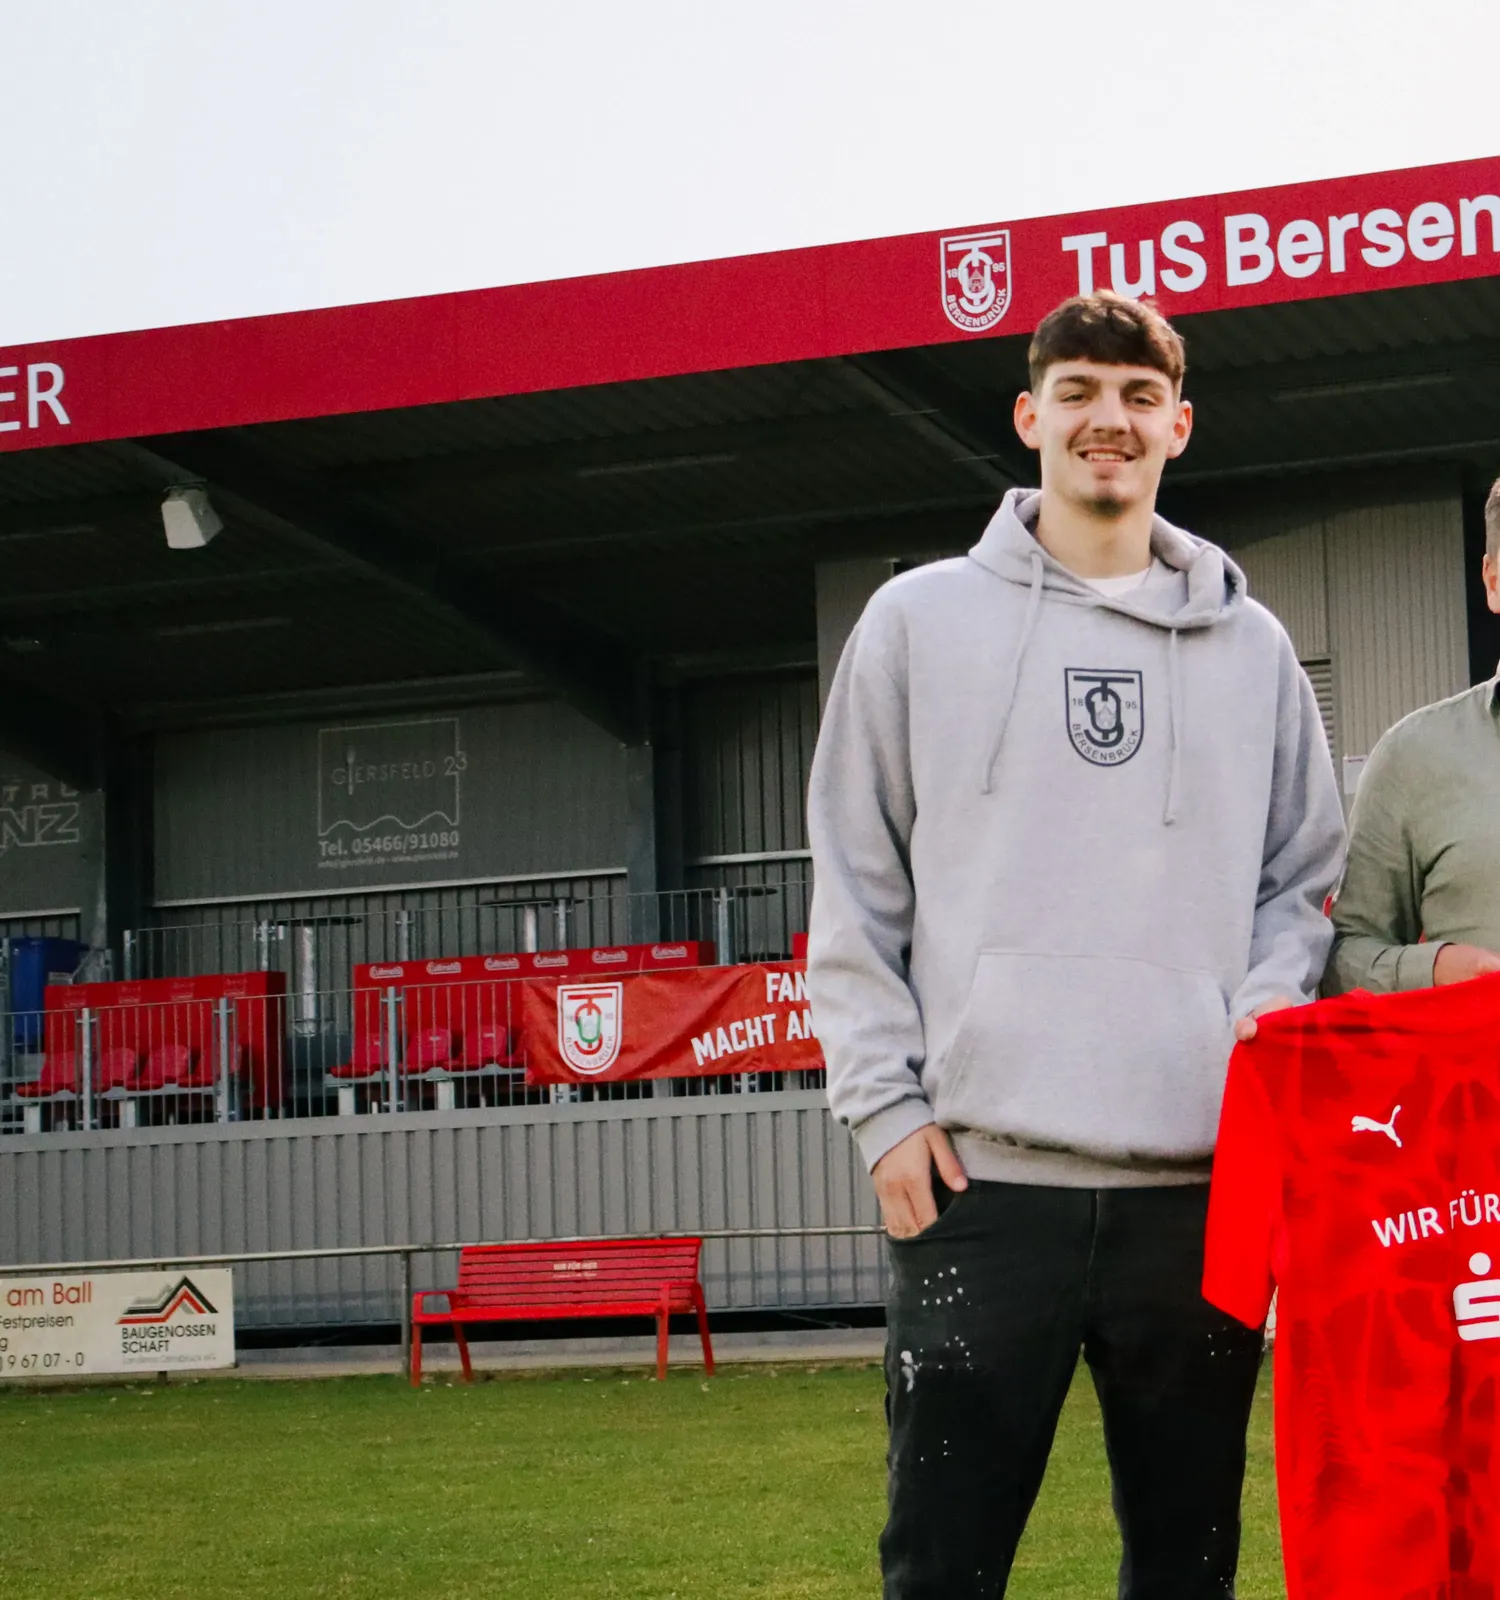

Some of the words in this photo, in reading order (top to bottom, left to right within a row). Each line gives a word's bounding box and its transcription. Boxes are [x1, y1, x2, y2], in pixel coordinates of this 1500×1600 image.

[1061, 220, 1208, 303] TuS
[0, 362, 71, 432] ER
[1072, 723, 1138, 761] BERSENBRÜCK
[444, 750, 468, 776] 23
[318, 838, 349, 857] Tel.
[351, 831, 460, 854] 05466/91080
[690, 1013, 777, 1067] MACHT
[1371, 1207, 1444, 1248] WIR
[7, 1287, 44, 1307] am
[53, 1281, 92, 1305] Ball
[121, 1324, 216, 1339] BAUGENOSSEN
[7, 1354, 16, 1369] 9
[21, 1353, 38, 1369] 67
[43, 1352, 61, 1368] 07
[75, 1351, 84, 1367] 0
[122, 1340, 170, 1354] SCHAFT
